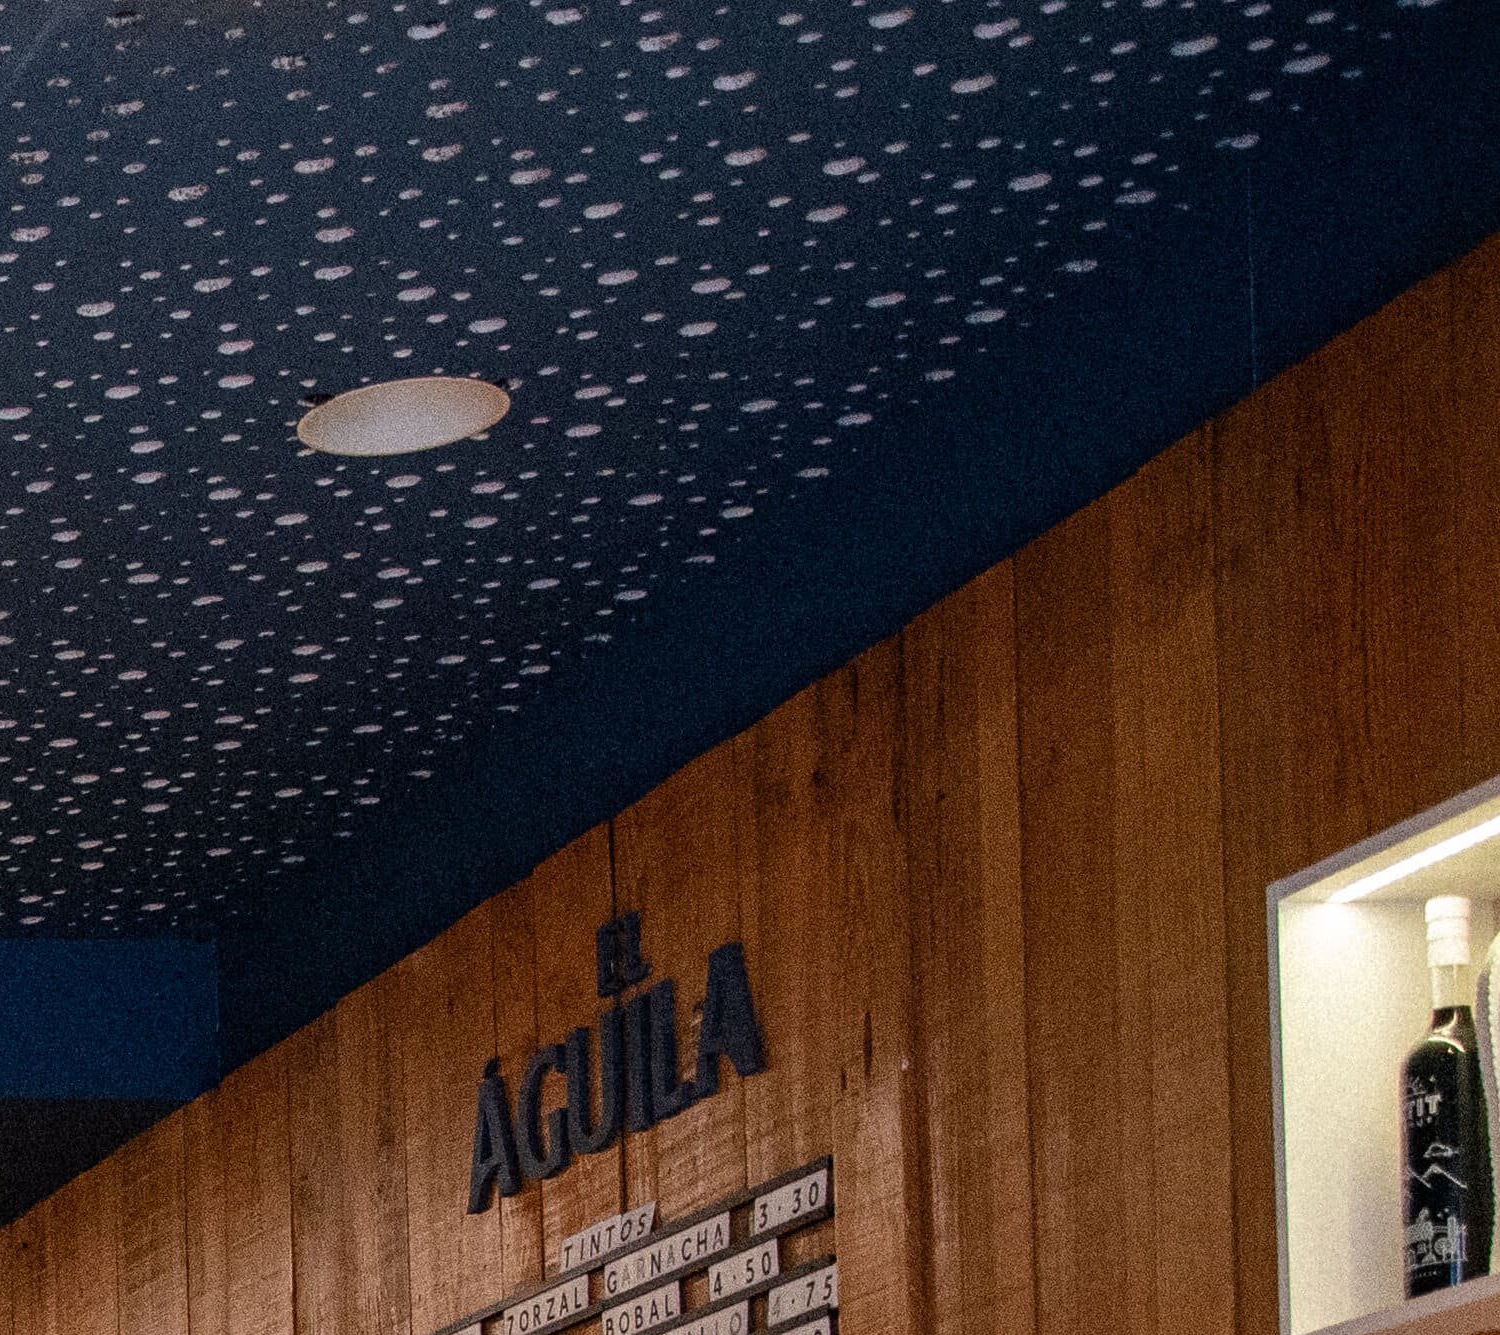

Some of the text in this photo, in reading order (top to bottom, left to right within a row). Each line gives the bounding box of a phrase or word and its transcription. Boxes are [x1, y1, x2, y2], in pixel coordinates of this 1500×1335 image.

[597, 911, 651, 998] EL
[563, 1211, 647, 1269] TINTOS
[607, 1223, 725, 1294] GARNACHA
